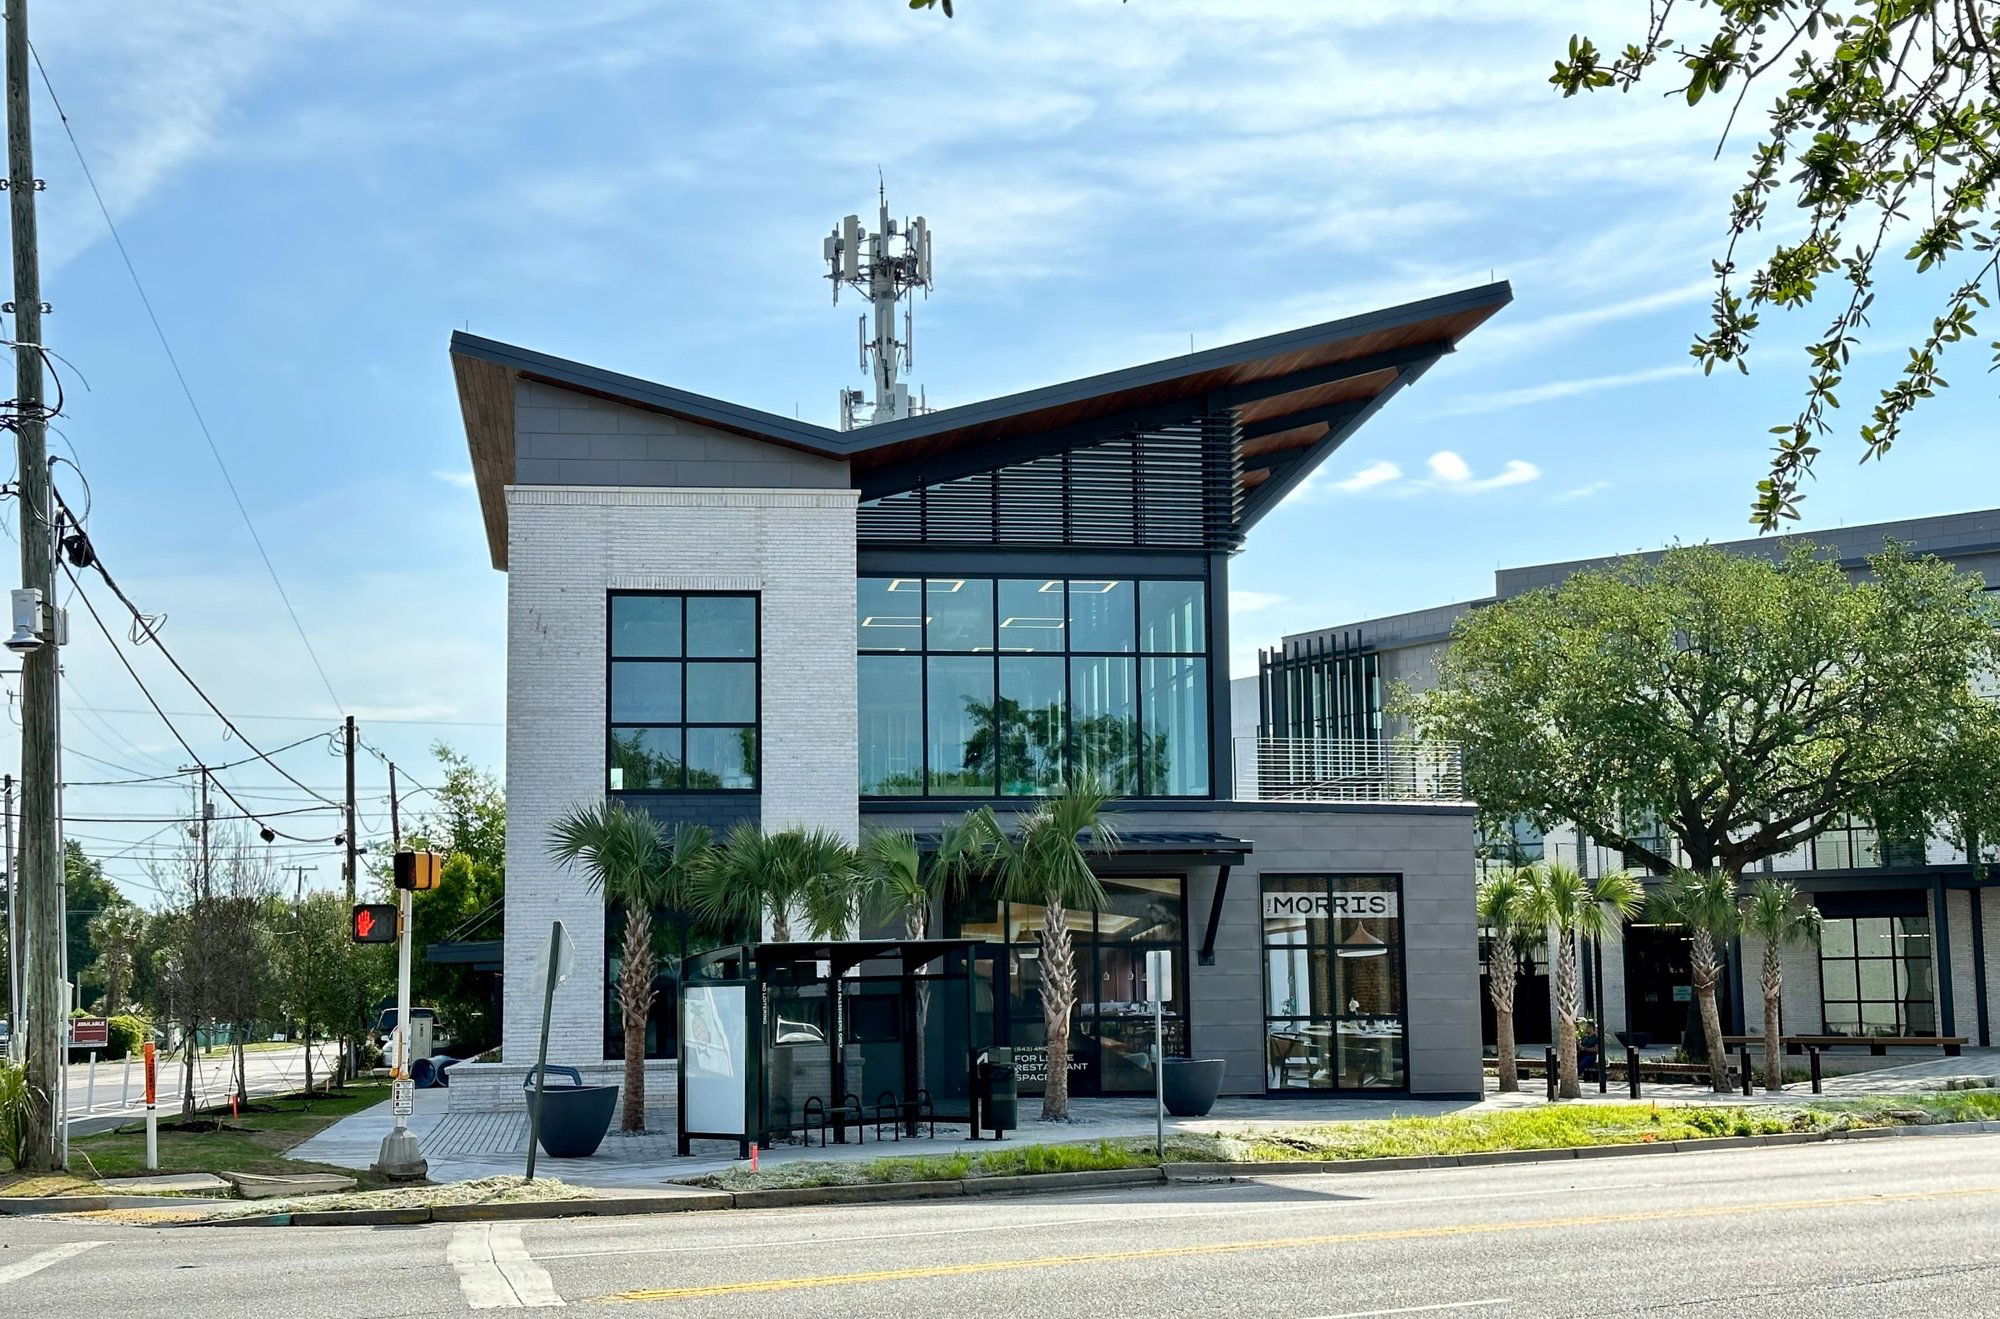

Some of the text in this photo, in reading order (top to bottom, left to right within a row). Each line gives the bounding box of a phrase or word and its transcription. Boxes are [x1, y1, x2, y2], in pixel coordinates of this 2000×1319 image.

[1273, 896, 1387, 914] MORRIS
[761, 982, 767, 992] NO
[1014, 1054, 1038, 1063] FOR
[1014, 1062, 1089, 1072] RESTAANT
